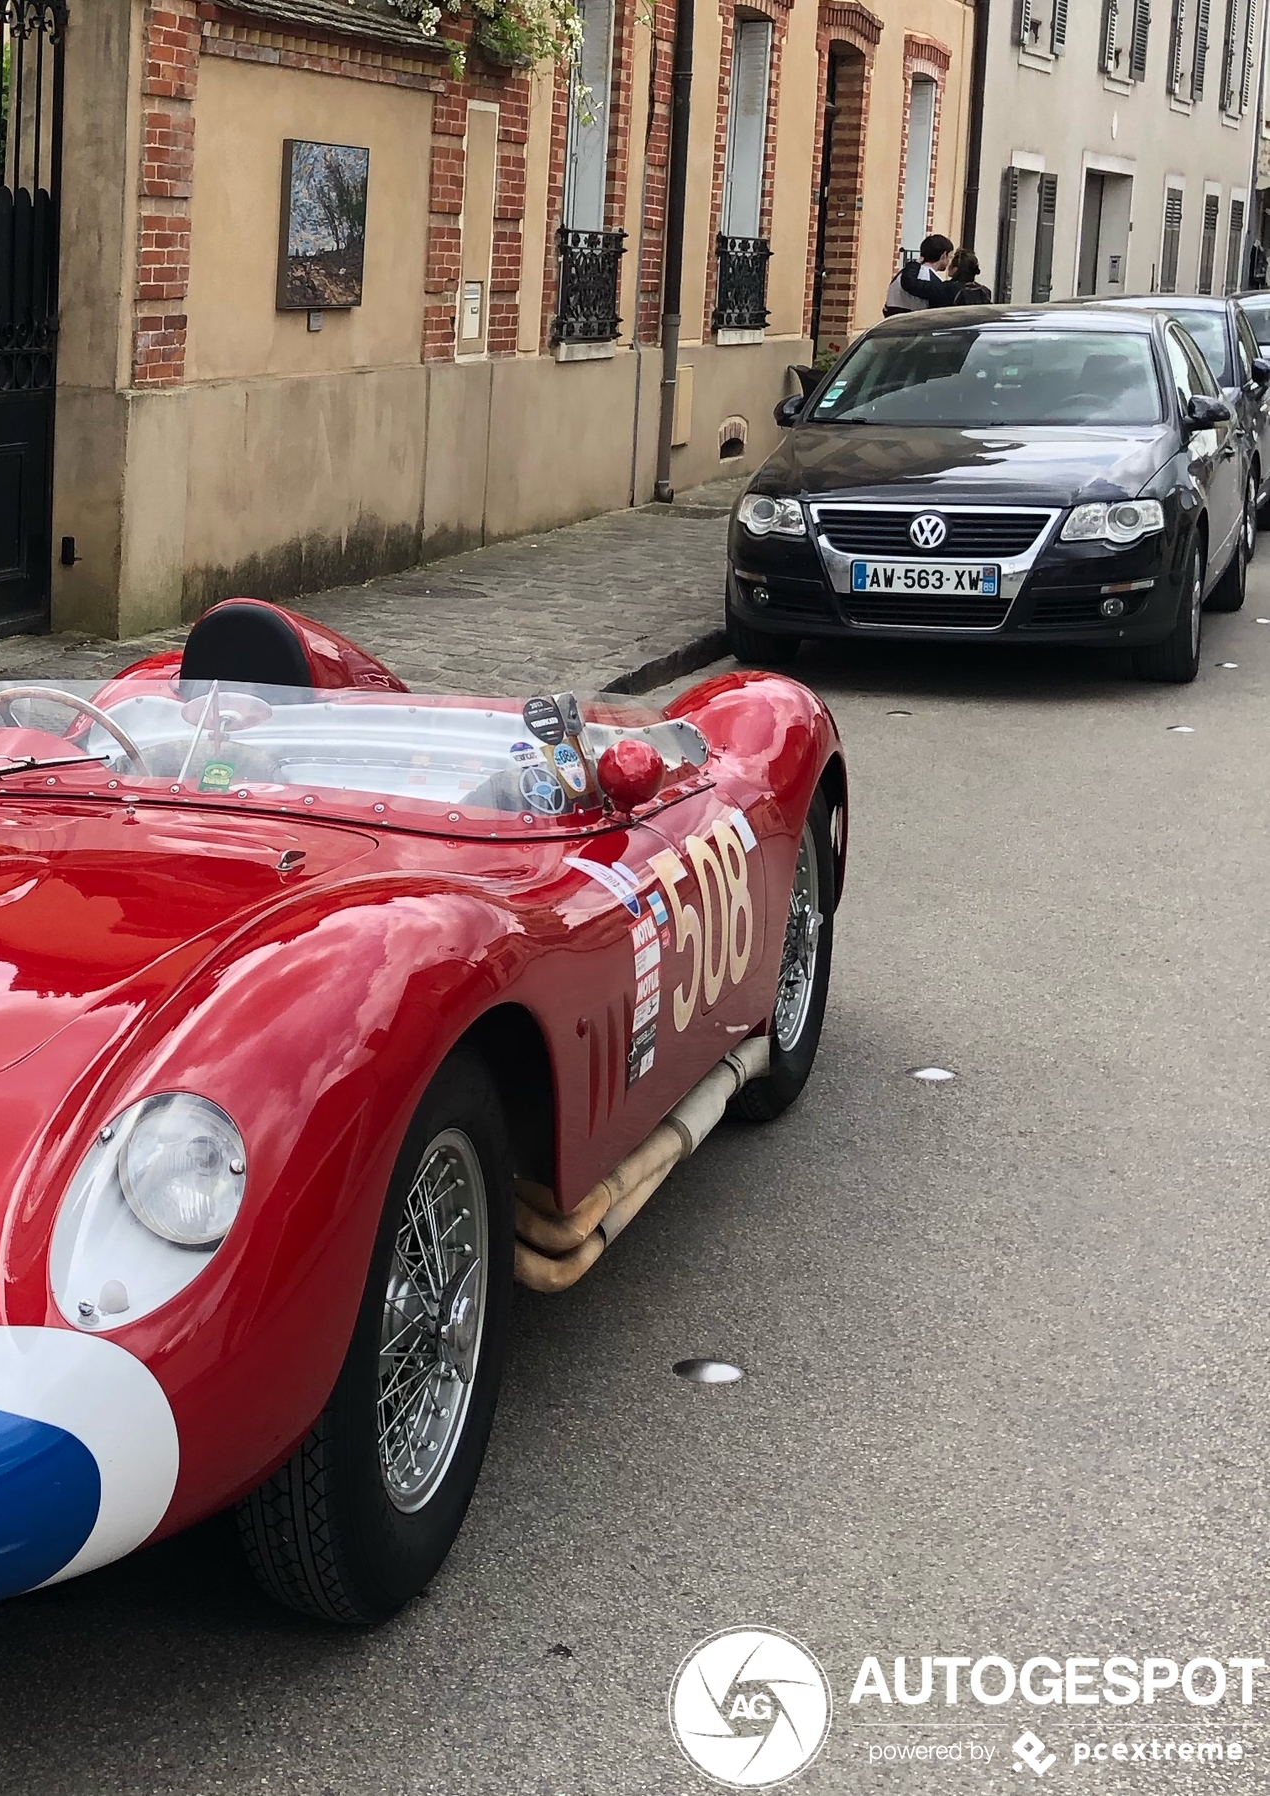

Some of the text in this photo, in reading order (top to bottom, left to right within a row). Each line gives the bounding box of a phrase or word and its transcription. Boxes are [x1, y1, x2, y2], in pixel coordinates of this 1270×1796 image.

[869, 567, 980, 591] AW-563-XW
[983, 582, 994, 592] 89
[632, 915, 657, 952] MOTUL
[647, 820, 752, 1032] 508
[636, 967, 660, 1004] MOTUL
